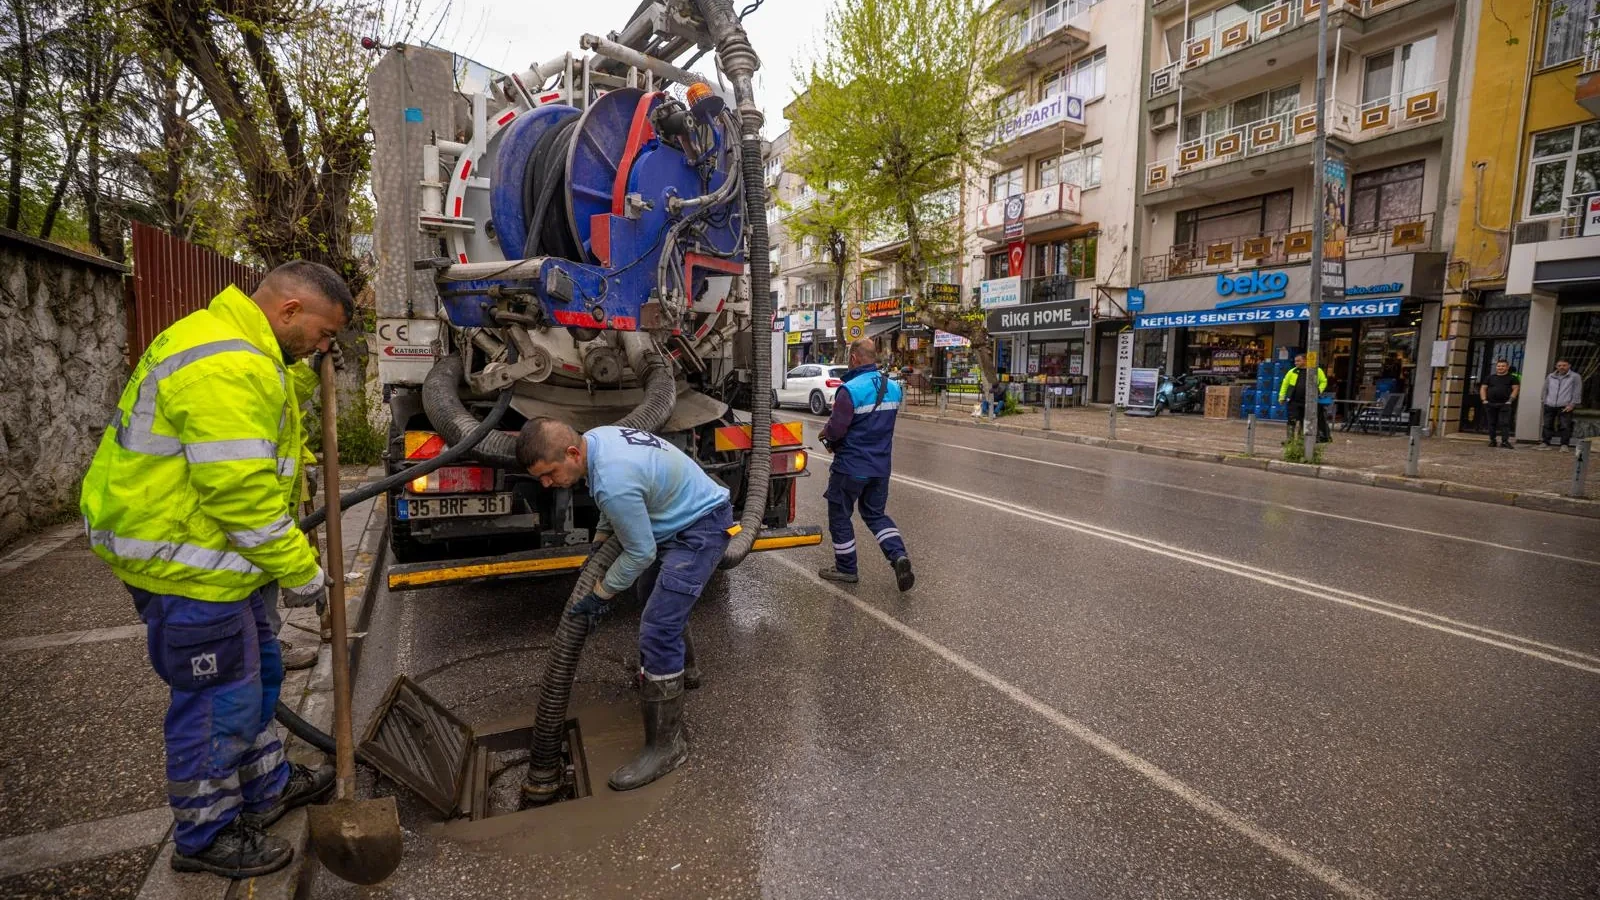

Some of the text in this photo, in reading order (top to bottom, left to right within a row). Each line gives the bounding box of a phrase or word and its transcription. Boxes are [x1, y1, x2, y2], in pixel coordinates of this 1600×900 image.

[1024, 95, 1061, 126] PARTİ
[1216, 269, 1288, 296] beko
[1345, 283, 1403, 296] eko.com.tr
[1001, 308, 1072, 328] RİKA HOME
[1141, 313, 1196, 326] KEFİLSİZ
[1200, 309, 1270, 323] SENETSİZ
[1275, 309, 1295, 319] 36
[1327, 302, 1398, 316] TAKSİT
[409, 500, 429, 516] 35
[440, 498, 468, 515] BRF
[478, 496, 506, 513] 361
